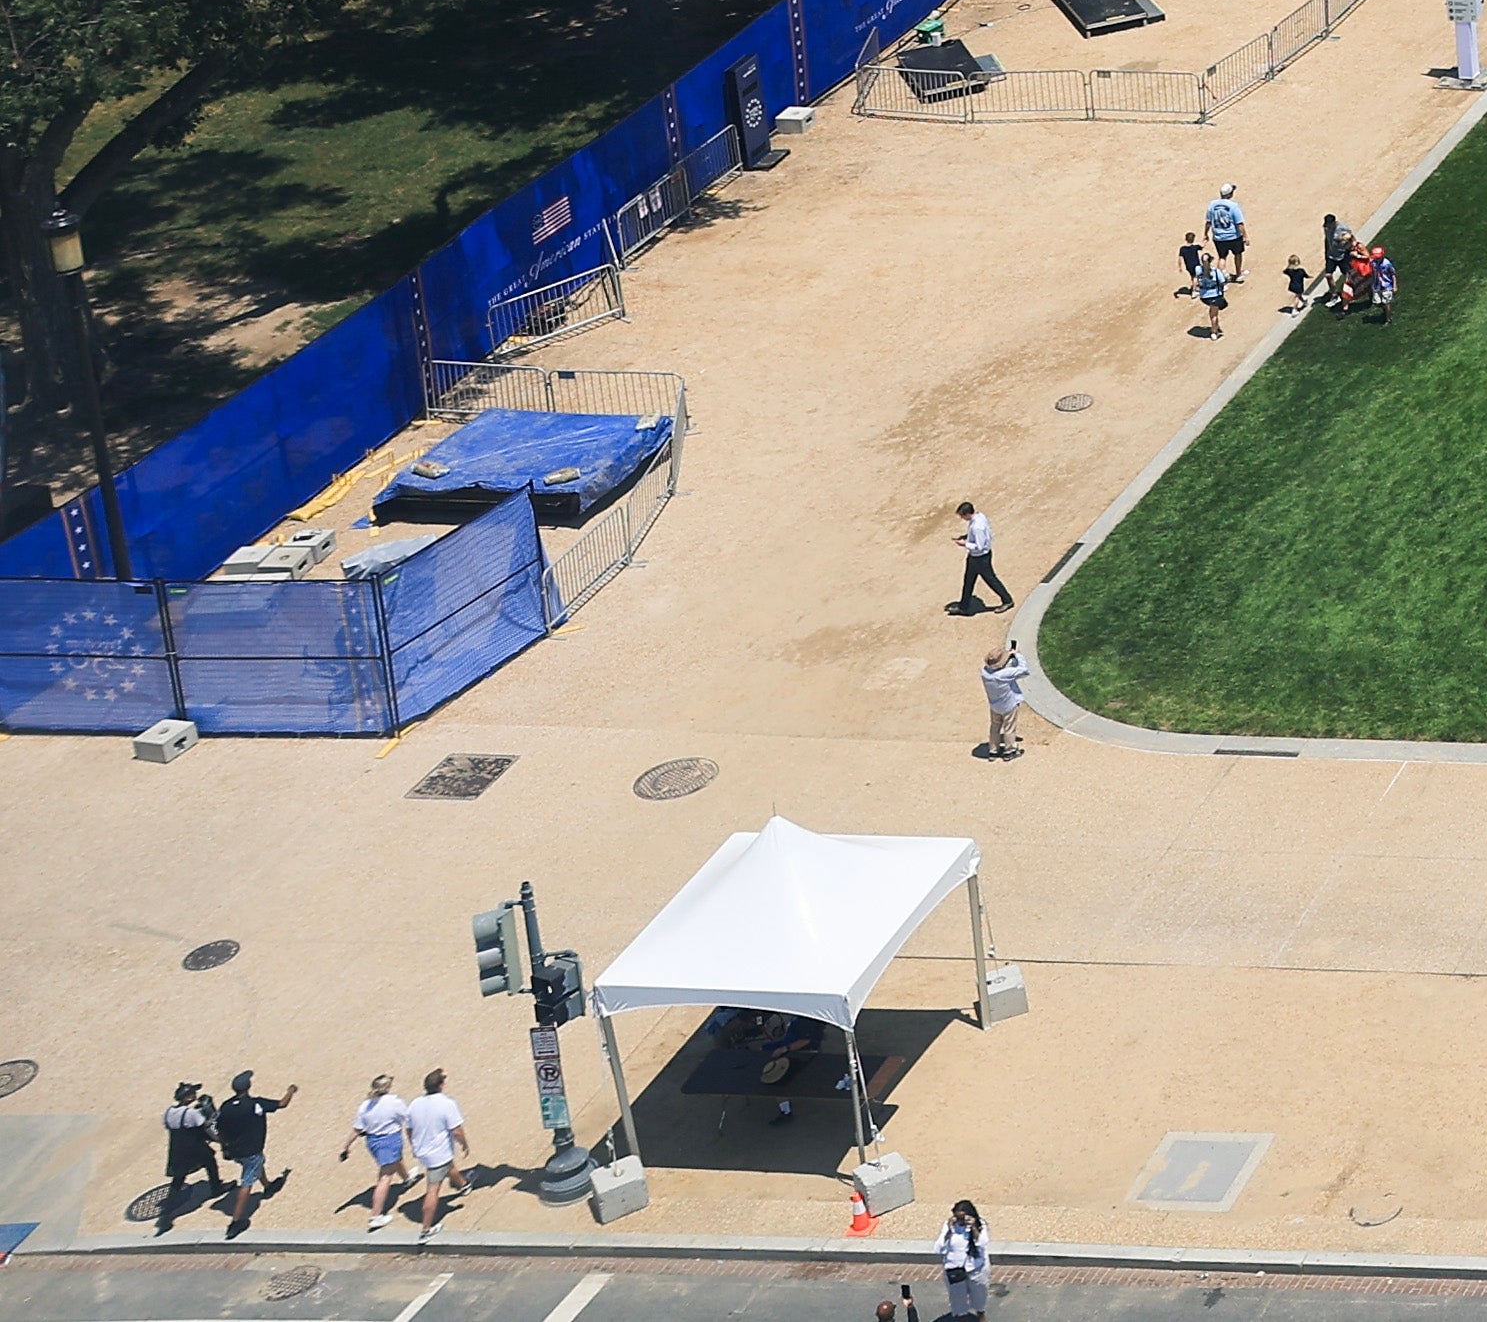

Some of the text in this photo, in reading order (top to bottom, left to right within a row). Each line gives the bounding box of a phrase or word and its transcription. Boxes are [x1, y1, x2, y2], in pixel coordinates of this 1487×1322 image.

[487, 292, 502, 307] THE
[503, 274, 526, 297] GREAT
[524, 236, 582, 288] American
